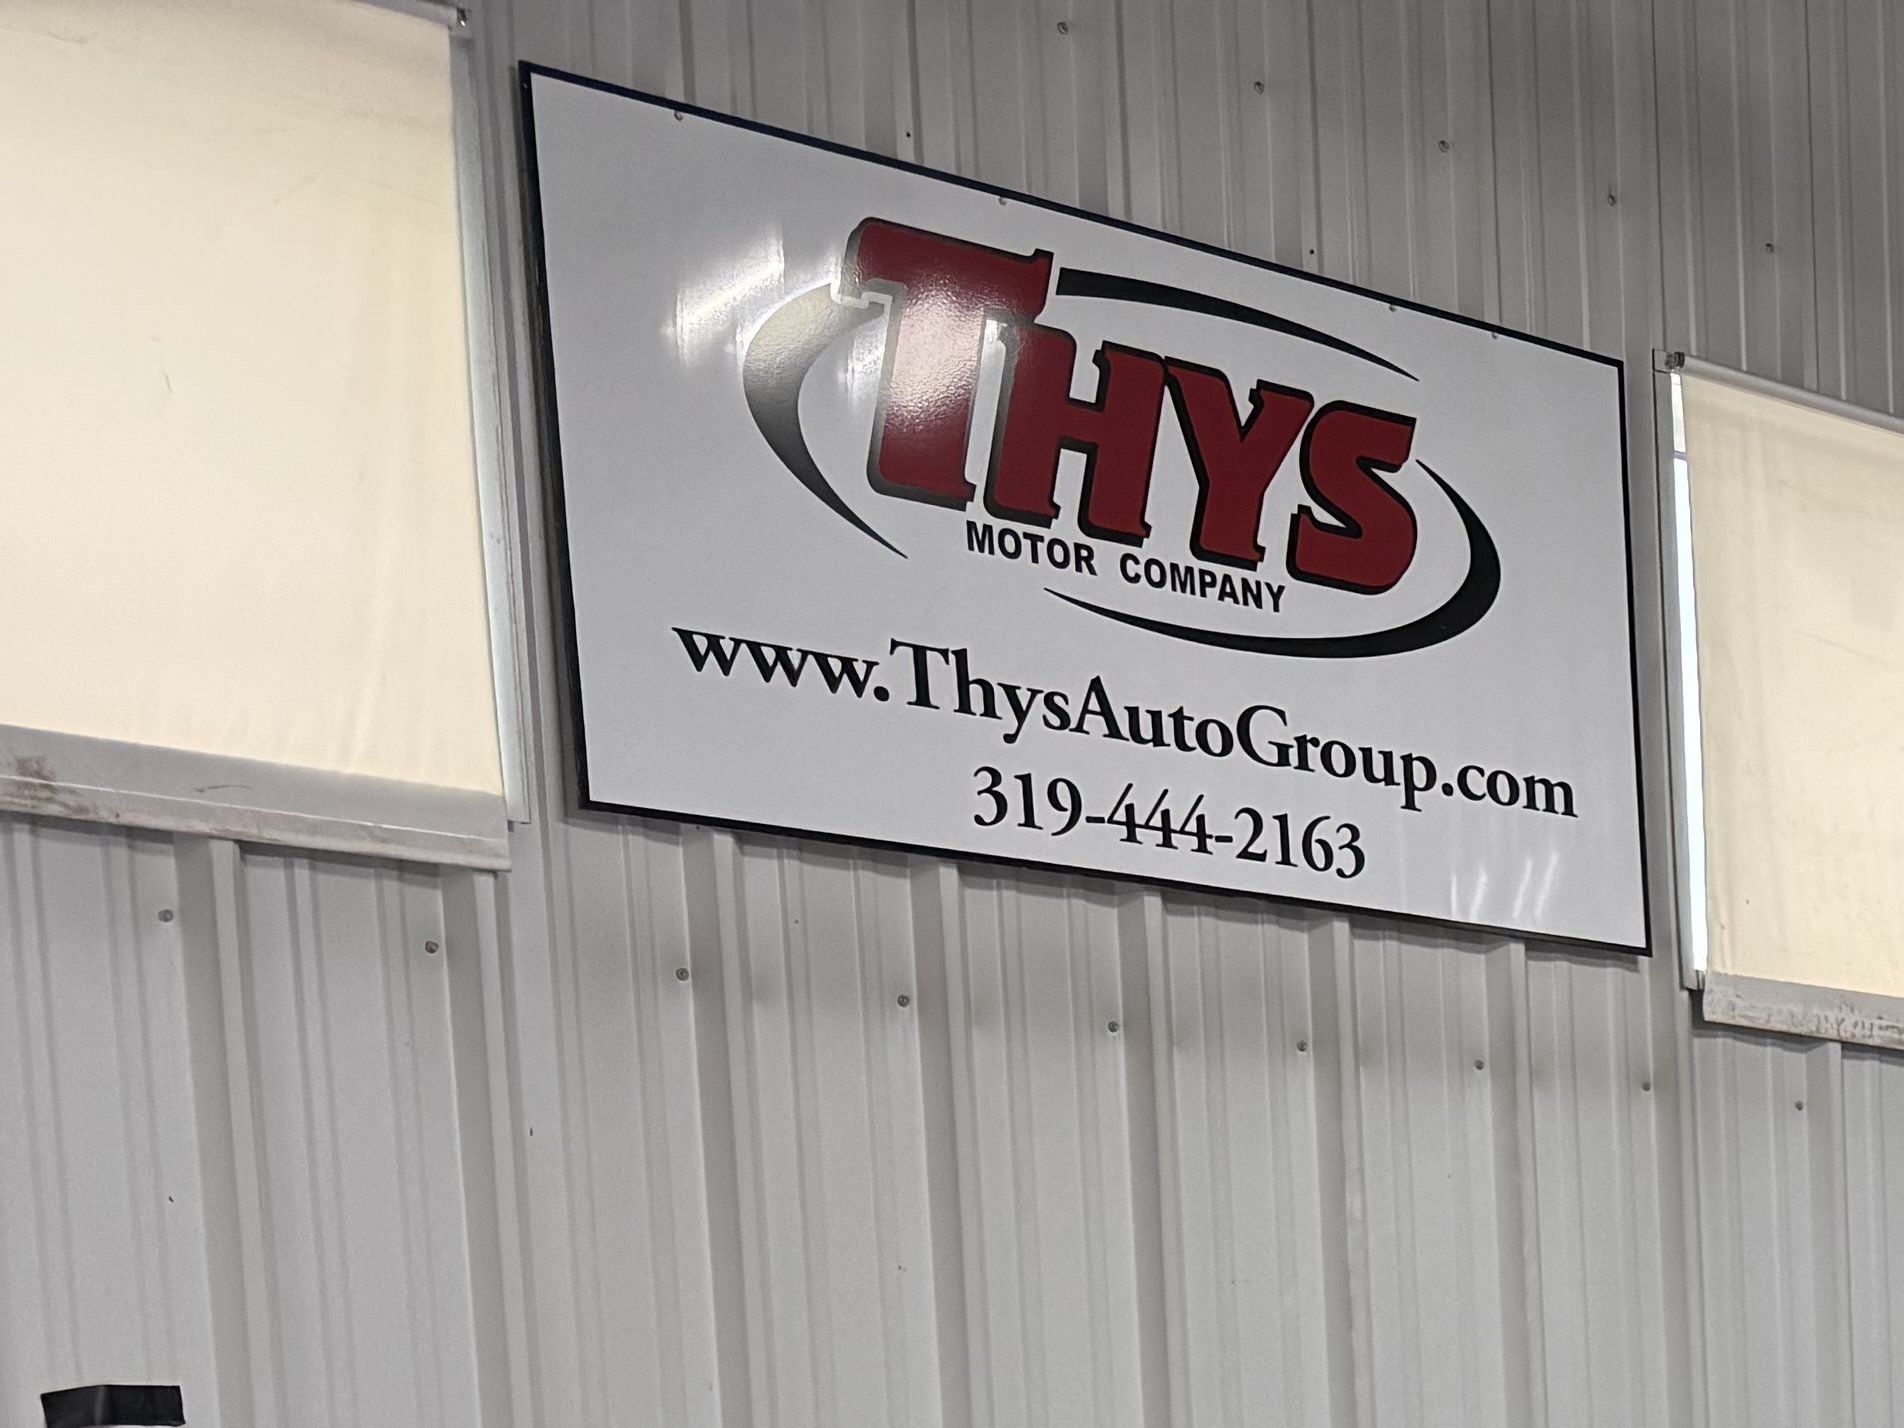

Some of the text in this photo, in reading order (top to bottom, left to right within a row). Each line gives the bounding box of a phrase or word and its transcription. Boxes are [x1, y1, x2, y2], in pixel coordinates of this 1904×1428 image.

[833, 216, 1419, 596] THYS
[966, 519, 1286, 615] MOTOR COMPANY
[671, 623, 1578, 821] www.ThysAutoGroup.com
[971, 764, 1366, 879] 319-444-2163
